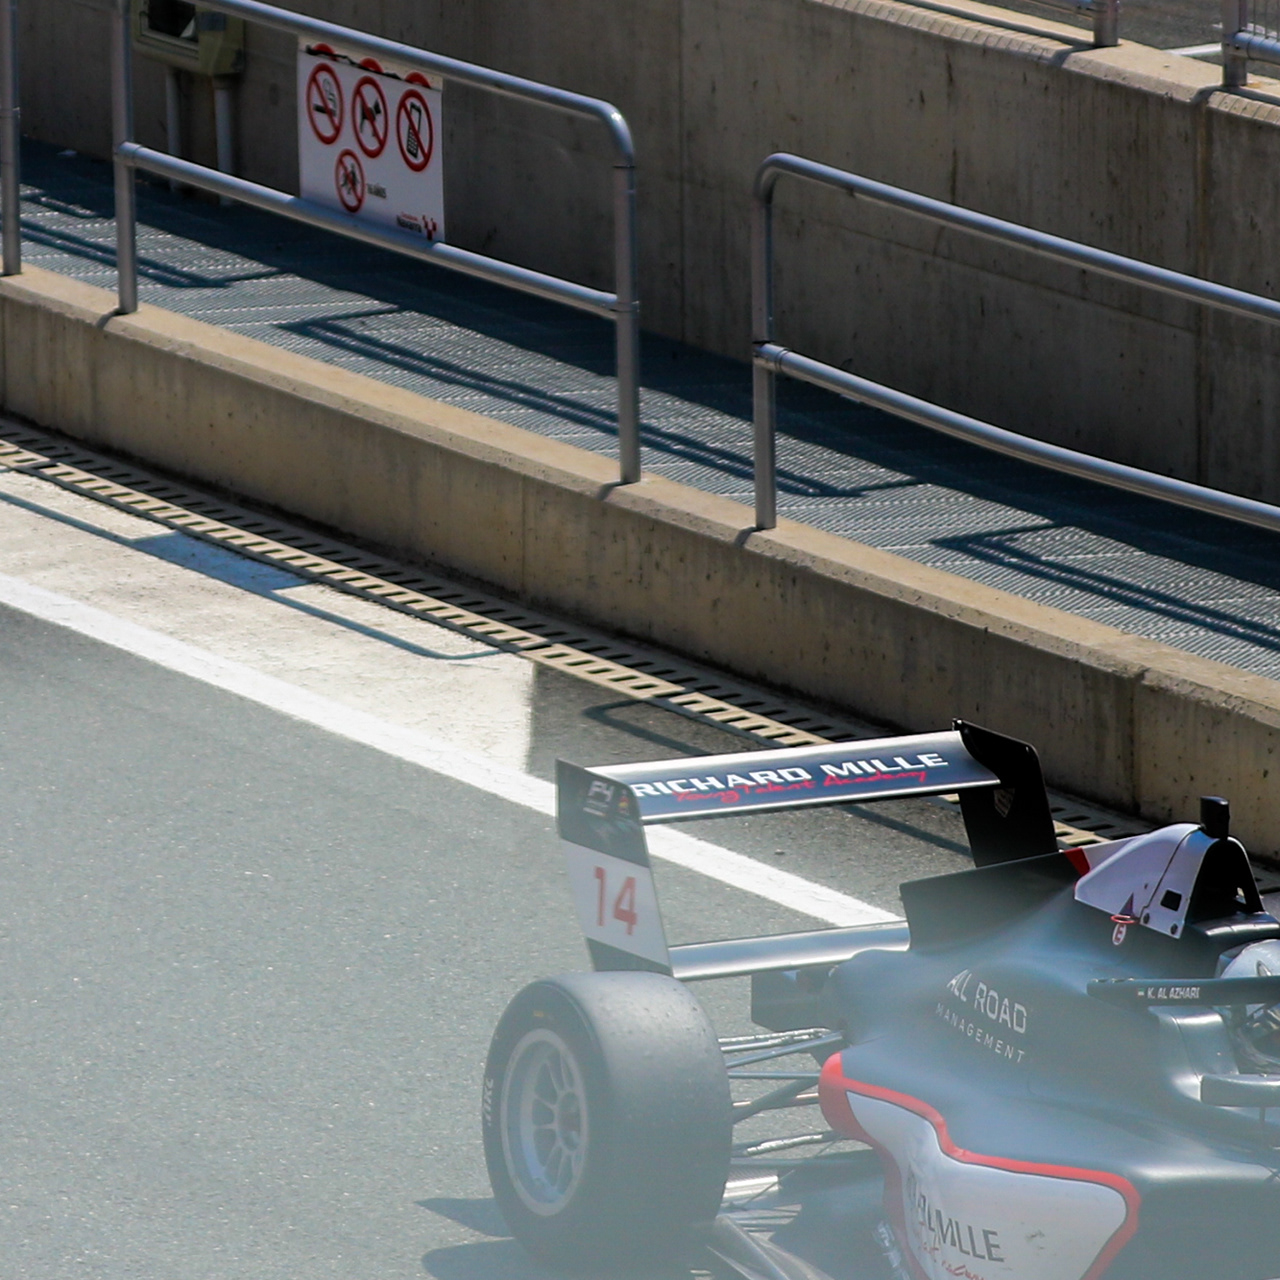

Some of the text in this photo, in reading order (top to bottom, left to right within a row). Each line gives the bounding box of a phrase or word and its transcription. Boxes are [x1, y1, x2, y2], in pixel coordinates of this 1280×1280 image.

[630, 752, 950, 799] RICHARD MILLE
[593, 865, 638, 936] 14
[946, 968, 1027, 1034] ALL ROAD
[1158, 987, 1167, 999] AL
[1169, 987, 1200, 999] AZHARI
[935, 1002, 1025, 1063] MANAGEMENT
